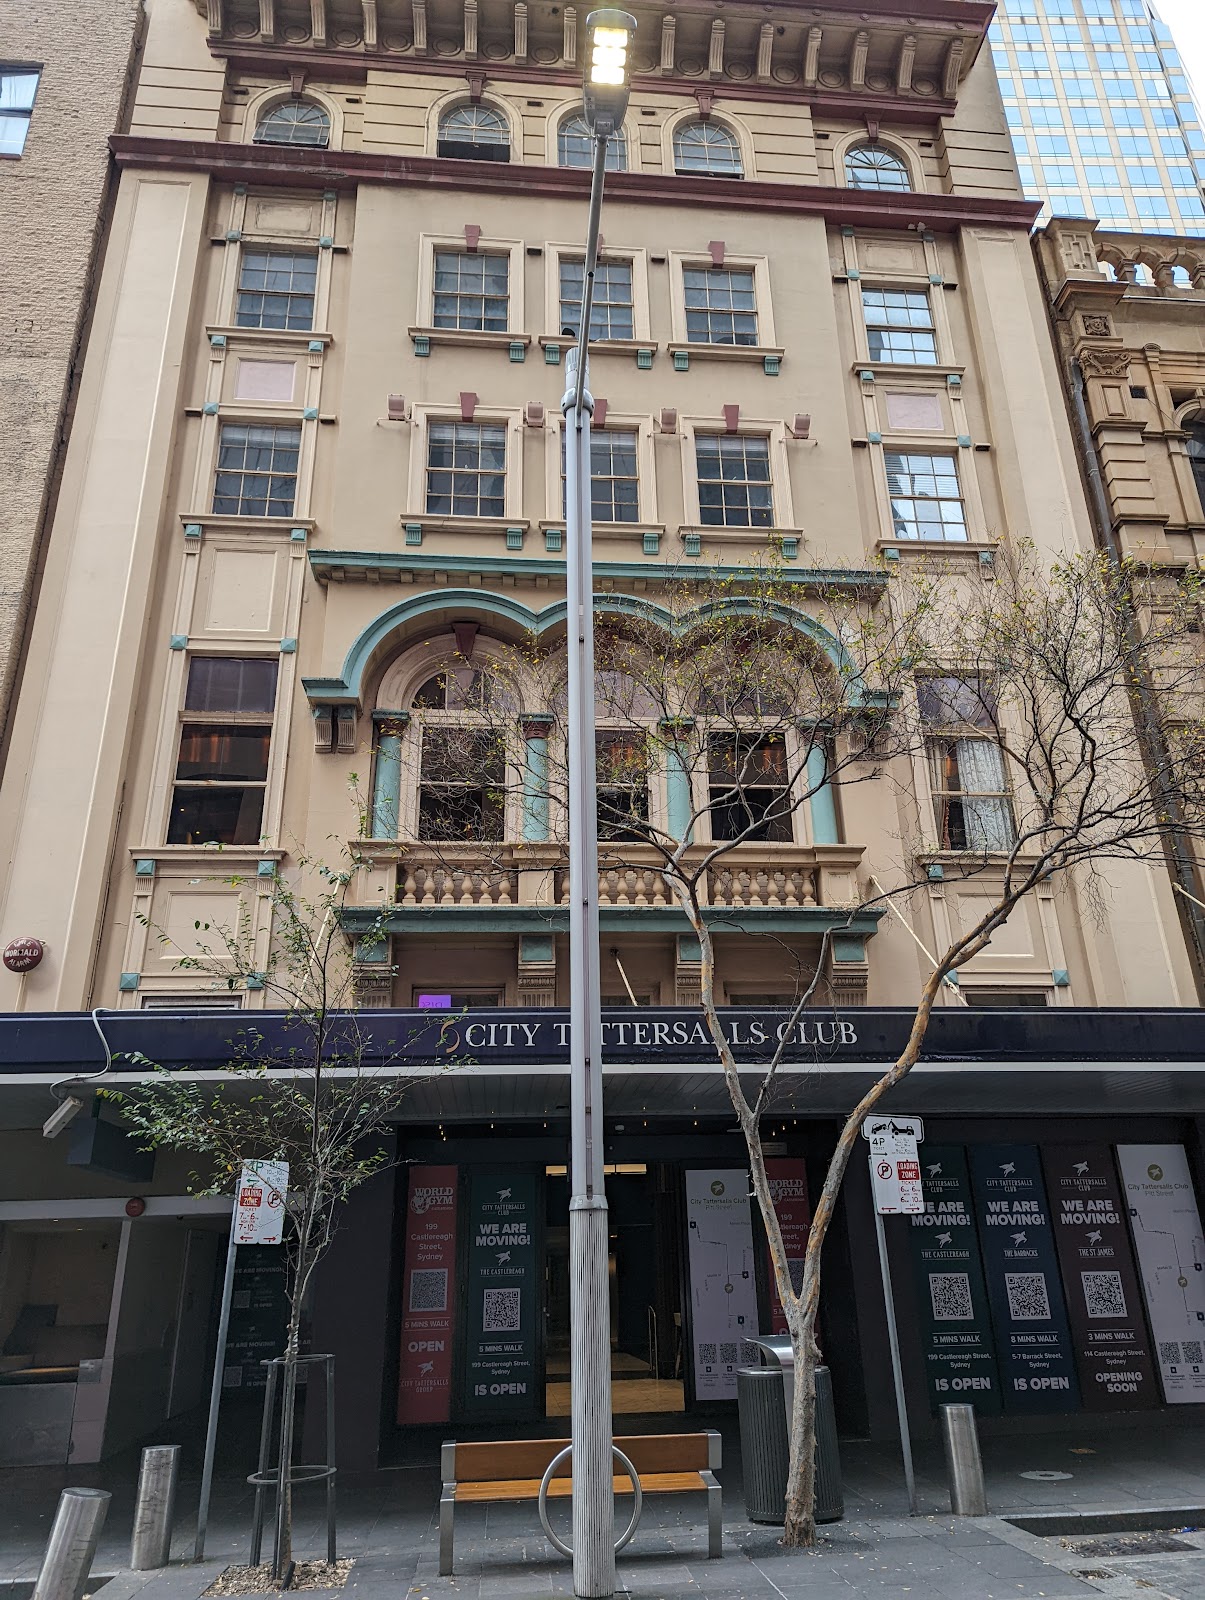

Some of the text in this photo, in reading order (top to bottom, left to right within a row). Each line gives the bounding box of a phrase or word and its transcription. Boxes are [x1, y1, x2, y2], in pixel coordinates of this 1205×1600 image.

[8, 958, 32, 967] ALARM
[465, 1021, 858, 1047] CITY TTTERSALS CLUB
[872, 1138, 885, 1146] 4P
[1060, 1178, 1107, 1186] CITY TATTERSALLS
[415, 1187, 454, 1197] WORLD
[781, 1188, 804, 1196] GYM
[428, 1196, 454, 1205] GYM
[938, 1202, 965, 1212] ARE
[987, 1201, 1039, 1212] WE ARE
[1061, 1200, 1114, 1212] WE ARE
[911, 1214, 971, 1226] MOVING!
[985, 1214, 1046, 1226] MOVING!
[1060, 1213, 1120, 1225] MOVING!
[480, 1223, 527, 1234] WE ARE
[780, 1222, 808, 1231] tlereagh
[411, 1233, 453, 1241] Castlereagh
[475, 1235, 531, 1246] MOVING!
[784, 1242, 801, 1251] dney
[1079, 1248, 1115, 1256] THE ST JAMES
[417, 1253, 443, 1261] Sydney
[939, 1335, 958, 1343] MINS
[1017, 1335, 1036, 1343] MINS
[1114, 1332, 1135, 1340] WALK
[408, 1340, 445, 1353] OPEN
[1093, 1350, 1127, 1358] Castlereagh
[950, 1361, 970, 1369] Sydney
[1029, 1361, 1050, 1369] Sydney
[1105, 1358, 1127, 1366] Sydney
[1095, 1371, 1143, 1382] OPENING
[935, 1377, 991, 1391] IS OPEN
[1014, 1377, 1070, 1391] IS OPEN
[1107, 1383, 1138, 1393] SOON
[474, 1382, 527, 1396] IS OPEN
